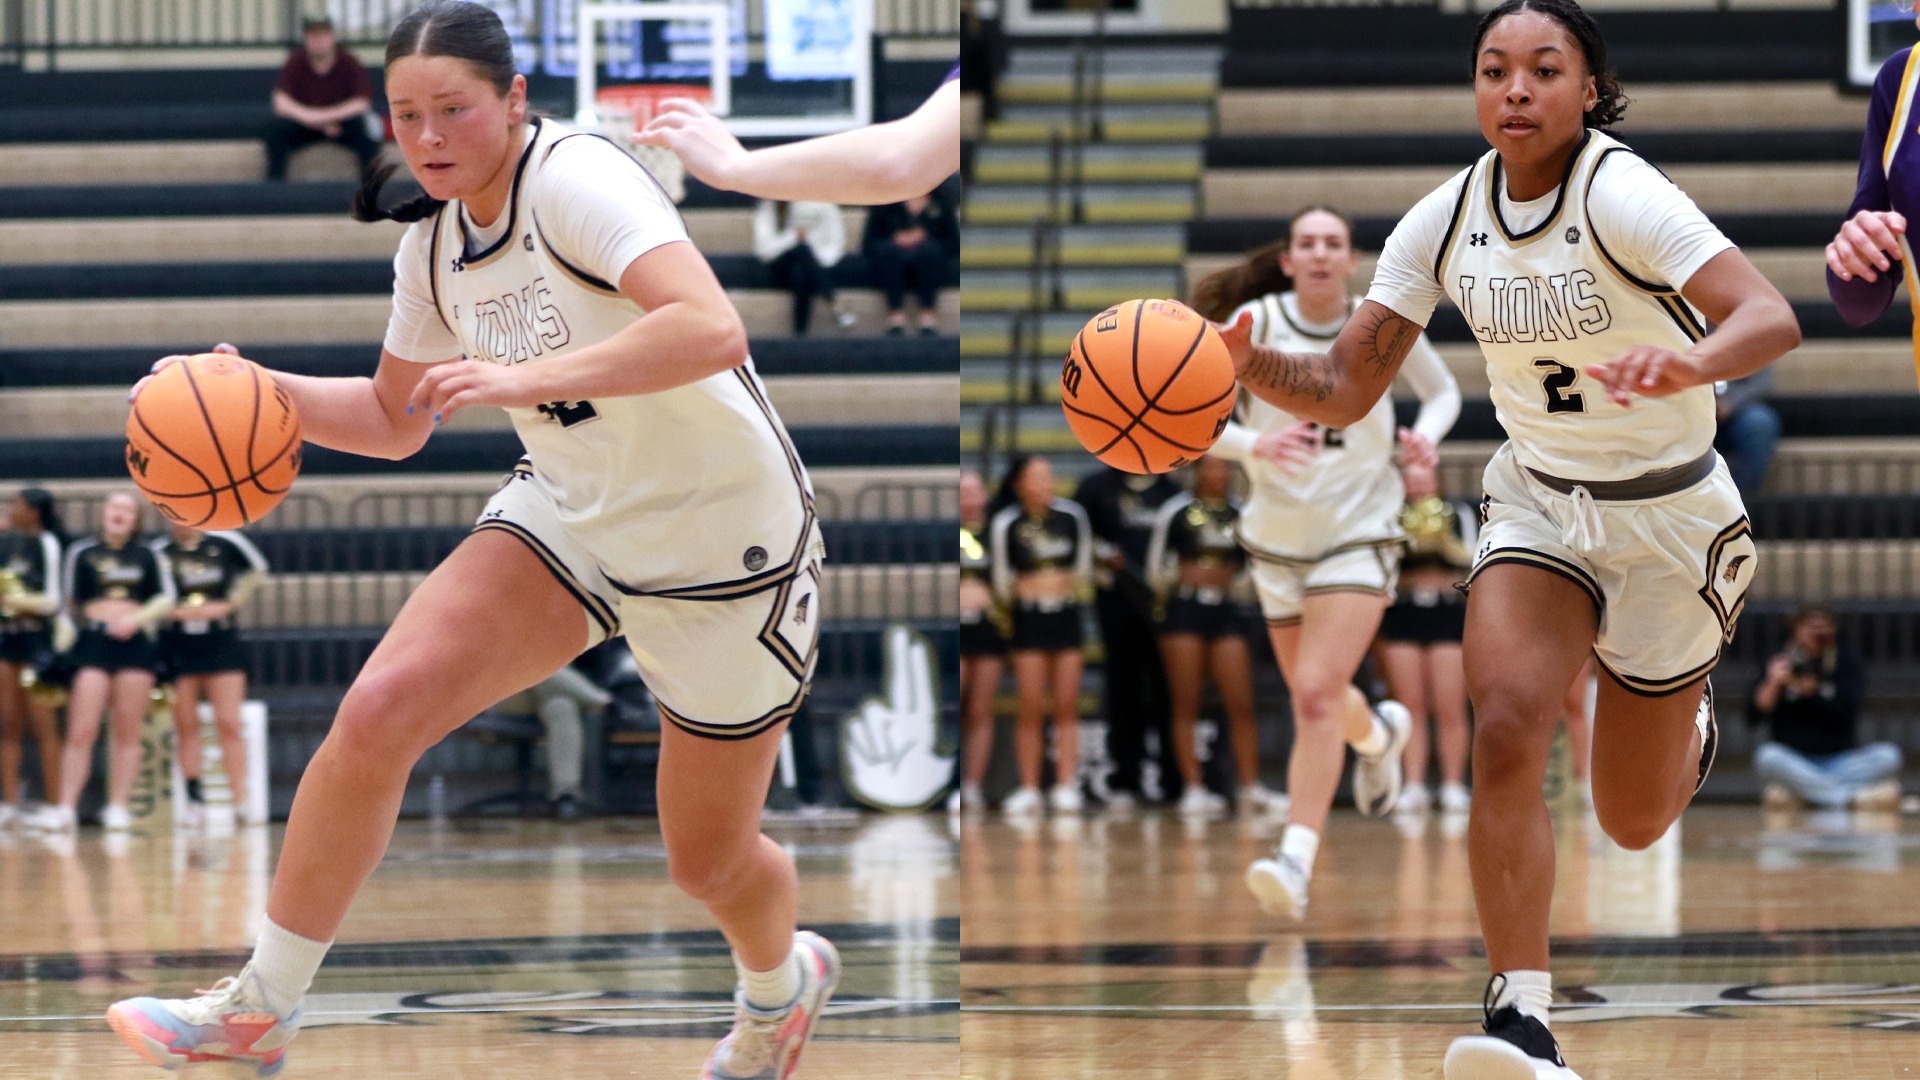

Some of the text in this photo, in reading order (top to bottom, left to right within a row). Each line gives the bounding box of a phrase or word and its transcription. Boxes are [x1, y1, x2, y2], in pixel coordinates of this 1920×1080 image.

[454, 277, 571, 367] IONS
[1460, 269, 1612, 343] LIONS
[1531, 357, 1588, 414] 2
